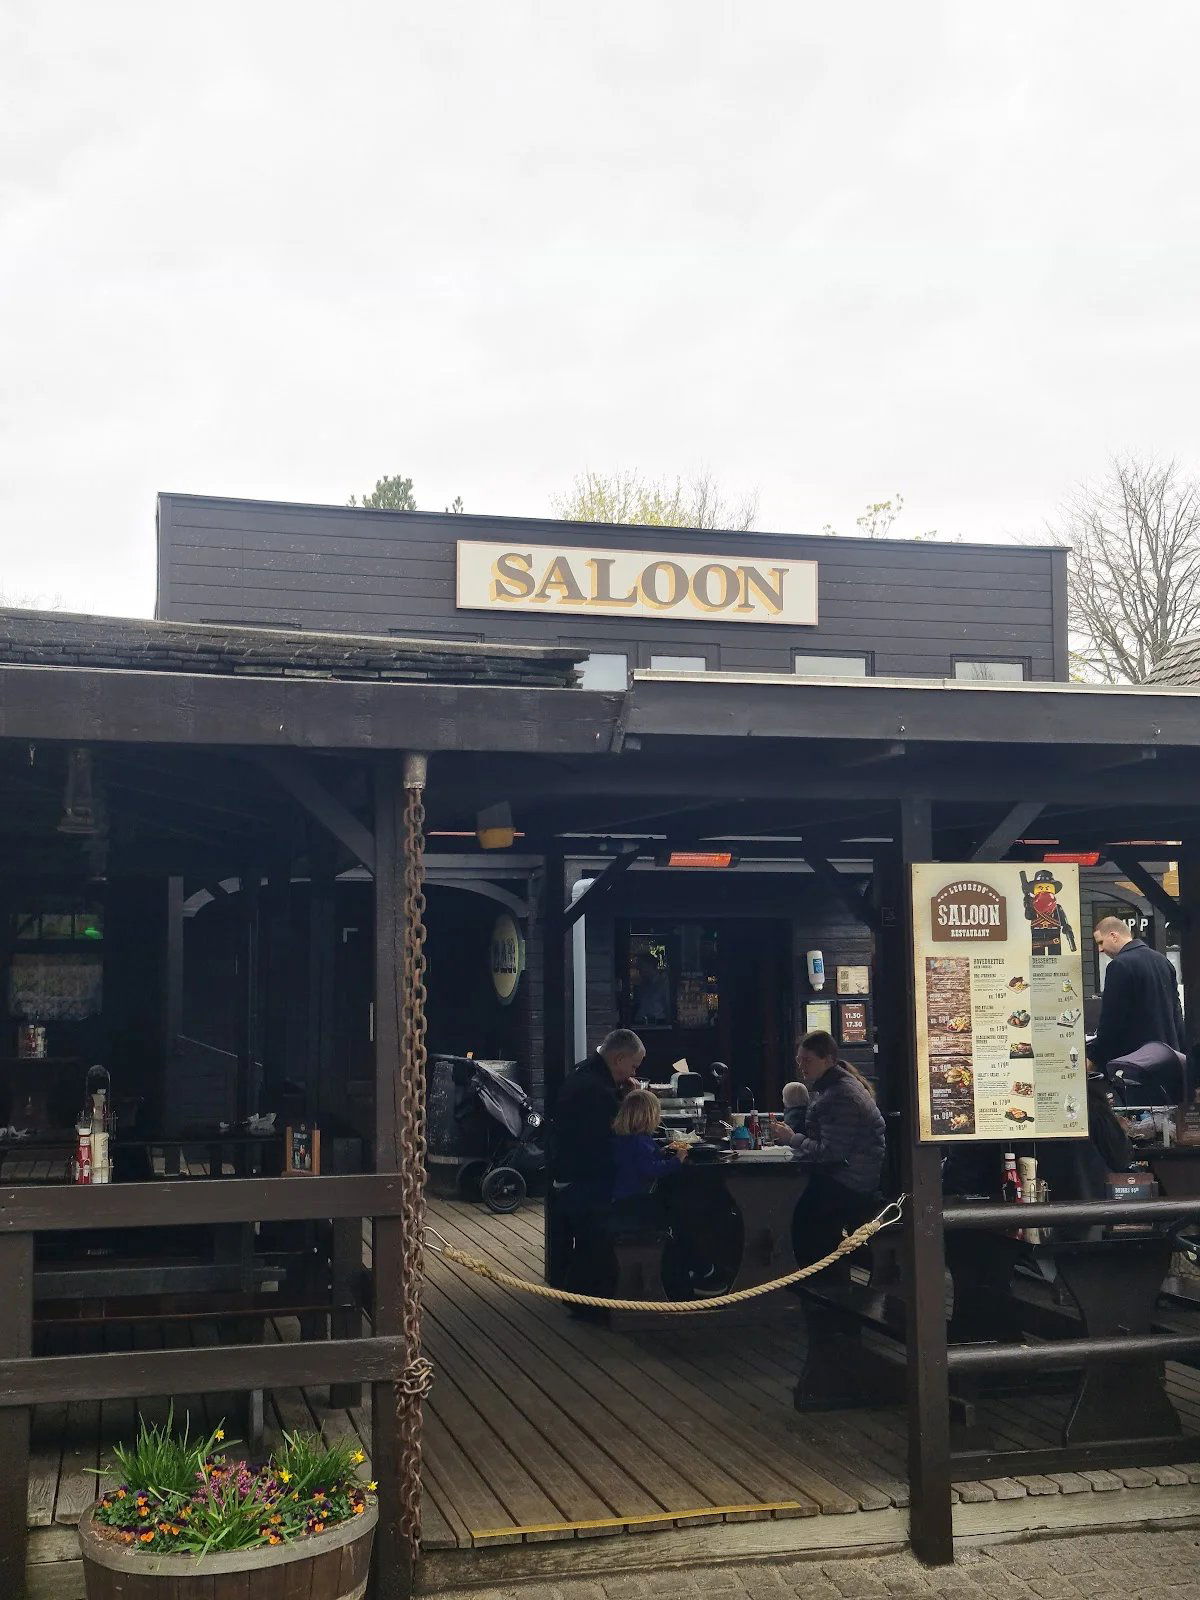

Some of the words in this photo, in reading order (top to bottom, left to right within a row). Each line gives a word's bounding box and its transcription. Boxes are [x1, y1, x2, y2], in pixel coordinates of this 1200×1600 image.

[489, 552, 789, 615] SALOON
[938, 904, 1000, 926] SALOON
[951, 929, 989, 937] RESTAURANT
